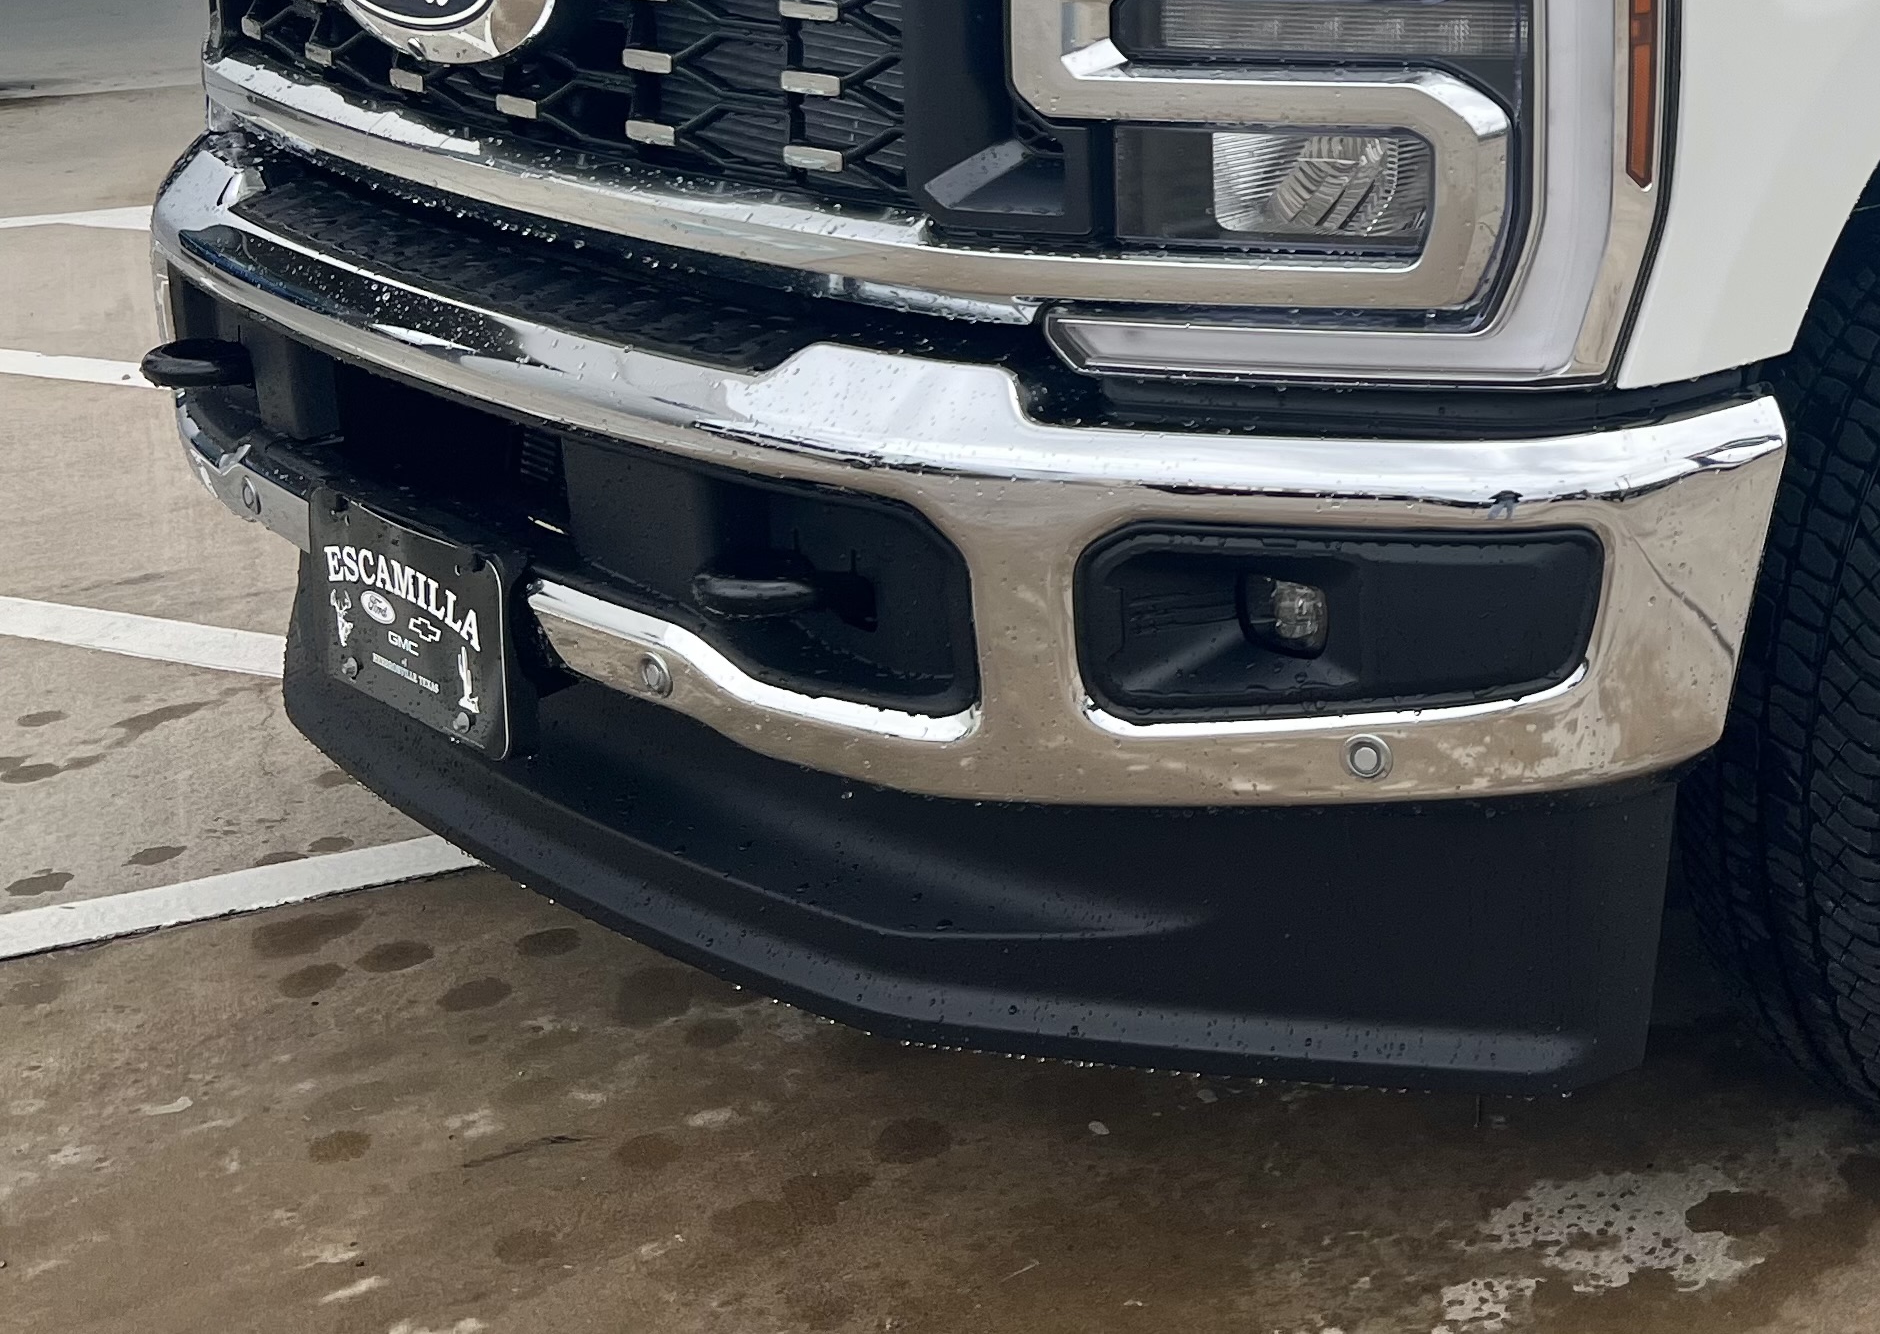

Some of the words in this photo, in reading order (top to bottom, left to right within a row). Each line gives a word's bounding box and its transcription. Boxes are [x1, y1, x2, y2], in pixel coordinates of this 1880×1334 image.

[323, 545, 481, 652] ESCAMILLA
[367, 594, 388, 618] Ford
[388, 630, 419, 656] GMC
